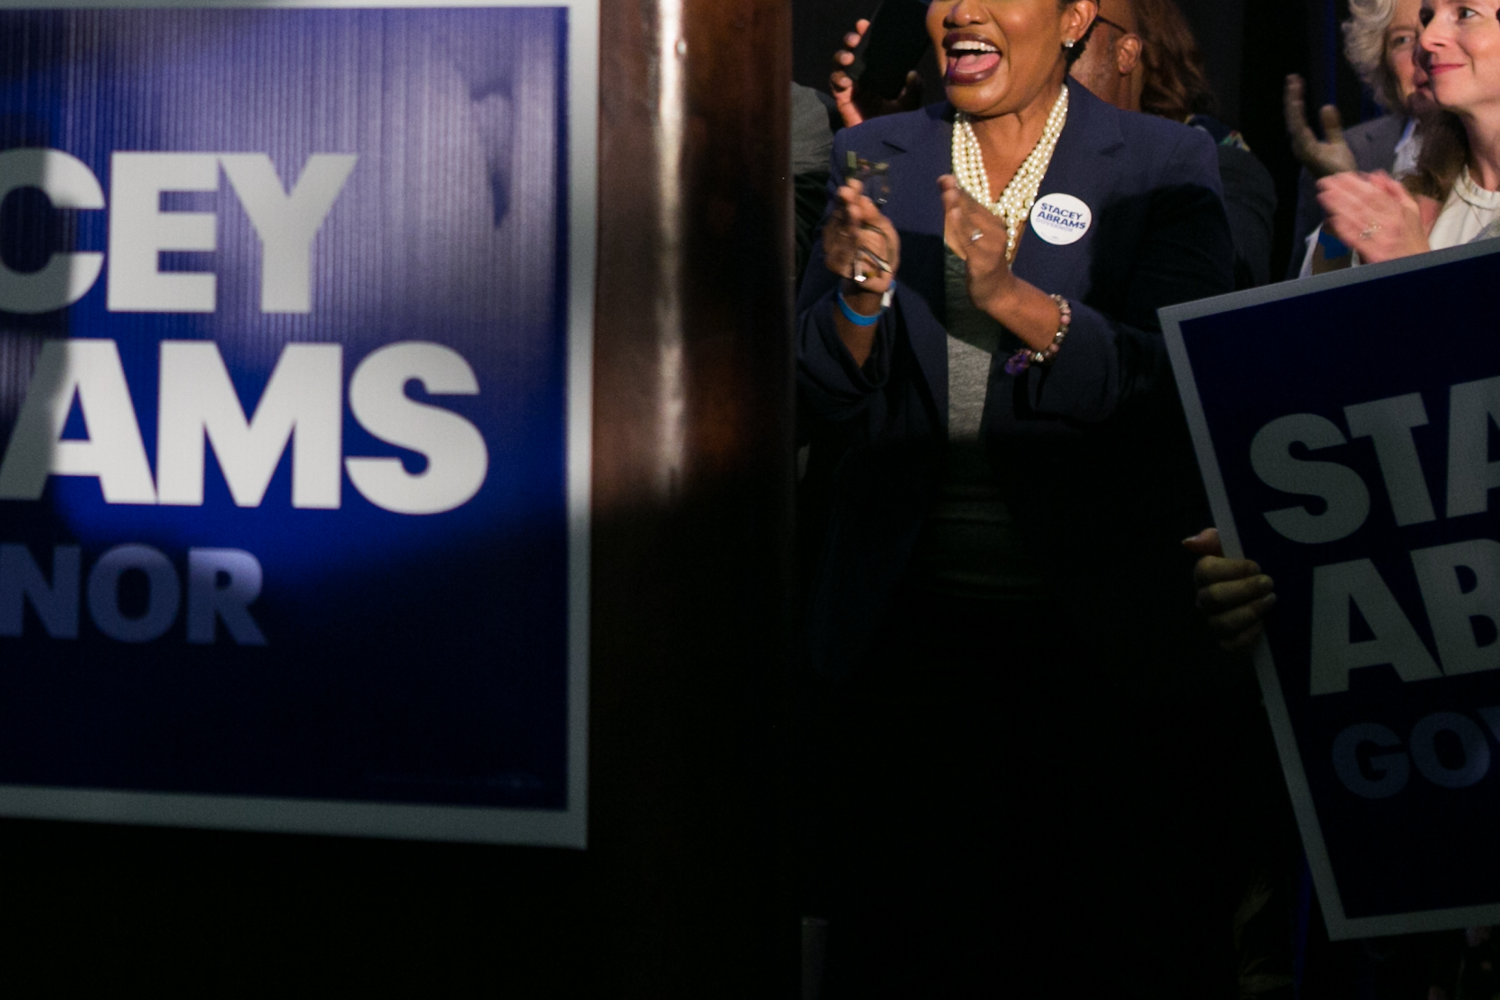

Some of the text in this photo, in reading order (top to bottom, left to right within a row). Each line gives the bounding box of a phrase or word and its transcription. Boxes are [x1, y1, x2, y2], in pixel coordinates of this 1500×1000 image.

[1037, 211, 1086, 230] ABRAMS
[1040, 203, 1083, 220] STACEY
[1332, 706, 1500, 800] GO
